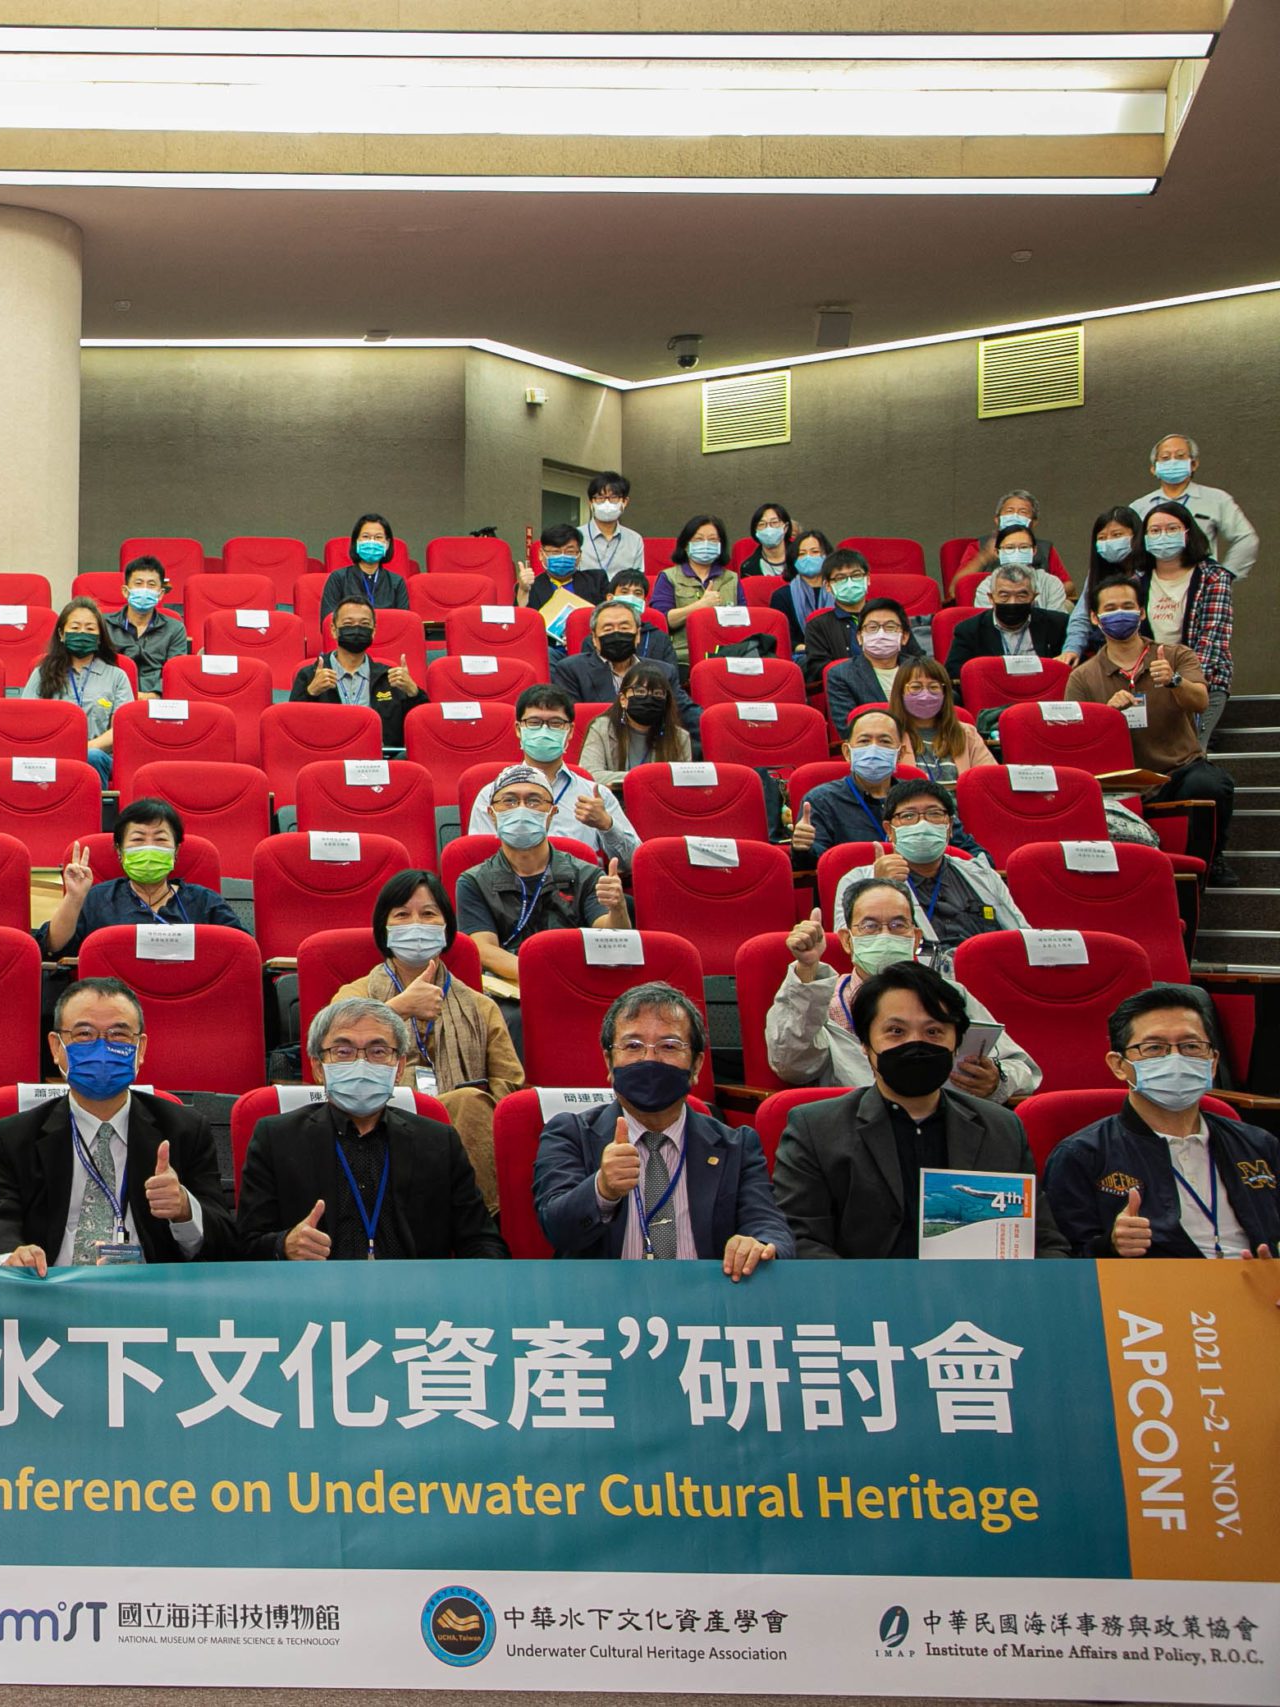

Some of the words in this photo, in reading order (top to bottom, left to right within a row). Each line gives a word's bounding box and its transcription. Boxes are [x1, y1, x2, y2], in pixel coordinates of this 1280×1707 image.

[34, 1088, 68, 1098] 蕭宗
[991, 1190, 1023, 1213] 4th
[1118, 1309, 1187, 1531] APCONF
[1190, 1311, 1223, 1373] 2021
[1210, 1462, 1243, 1539] NOV.
[211, 1481, 270, 1512] on
[289, 1470, 584, 1515] Underwater
[600, 1472, 803, 1518] Cultural
[818, 1474, 1038, 1533] Heritage
[117, 1601, 340, 1631] 國立海洋科技博物館
[503, 1605, 789, 1634] 中華水下文化資產學會
[922, 1609, 1260, 1641] 中華民國海洋事務與政策協會
[118, 1635, 158, 1644] NATIONAL
[160, 1636, 196, 1645] MUSEUM
[197, 1636, 208, 1645] OF
[210, 1636, 241, 1645] MARINE
[242, 1637, 275, 1645] SCIENCE
[277, 1637, 284, 1645] &
[285, 1637, 341, 1646] TECHNOLOGY
[506, 1643, 587, 1658] Underwater
[589, 1644, 643, 1659] Cultural
[646, 1645, 706, 1663] Heritage
[708, 1646, 788, 1661] Association
[924, 1641, 989, 1657] Institute
[992, 1643, 1009, 1658] of
[1010, 1643, 1064, 1659] Marine
[1067, 1644, 1118, 1660] Affairs
[1122, 1646, 1150, 1661] and
[1153, 1646, 1207, 1667] Policy,
[1210, 1648, 1264, 1665] R.O.C.
